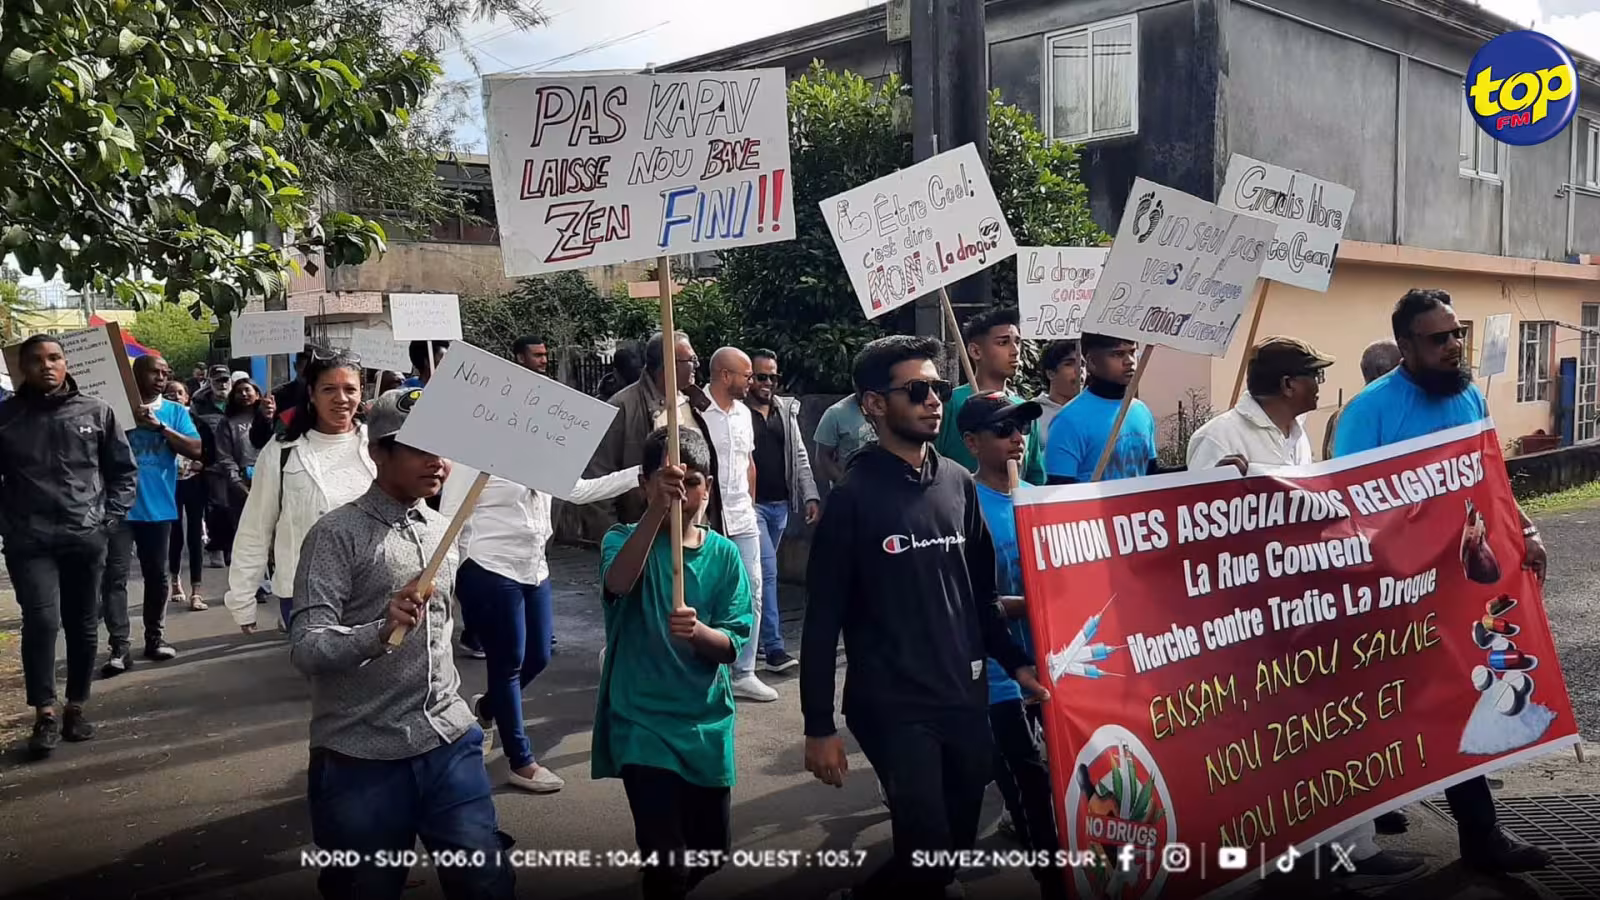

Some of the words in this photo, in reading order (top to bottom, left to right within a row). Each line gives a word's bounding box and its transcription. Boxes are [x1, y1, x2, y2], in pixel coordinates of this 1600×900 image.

[530, 85, 628, 147] PAS
[644, 77, 761, 140] KAPAV
[520, 155, 611, 200] LAISSE
[628, 147, 694, 185] NOU
[544, 200, 631, 263] ZEN
[863, 236, 898, 270] c'est
[903, 226, 934, 250] dire
[1157, 213, 1190, 249] un
[1186, 214, 1239, 256] seul
[867, 251, 925, 311] NON
[1026, 251, 1046, 285] La
[1140, 257, 1184, 286] vers
[454, 360, 490, 388] Non
[500, 376, 512, 397] à
[524, 388, 541, 407] la
[547, 400, 591, 431] drogue
[526, 418, 540, 435] la
[546, 433, 567, 447] vie
[1032, 518, 1112, 571] L'UNION
[1112, 508, 1169, 556] DES
[1183, 560, 1212, 598] La
[1218, 551, 1260, 590] Rue
[1265, 531, 1373, 579] Couvent
[1126, 622, 1201, 674] Marche
[1202, 605, 1264, 651] contre
[1267, 588, 1337, 631] Trafic
[1343, 583, 1372, 616] La
[1378, 567, 1437, 609] Drogue
[1150, 674, 1248, 740] ENSAM,
[1255, 638, 1339, 701] ANOU
[1352, 612, 1442, 670] SAUVE
[1205, 729, 1263, 794] NOU
[1267, 691, 1368, 763] ZENESS
[1378, 679, 1406, 720] ET
[1219, 796, 1277, 852] NOU
[1282, 740, 1405, 828] LENDROIT
[1086, 815, 1104, 838] NO
[1106, 819, 1157, 848] DRUGS
